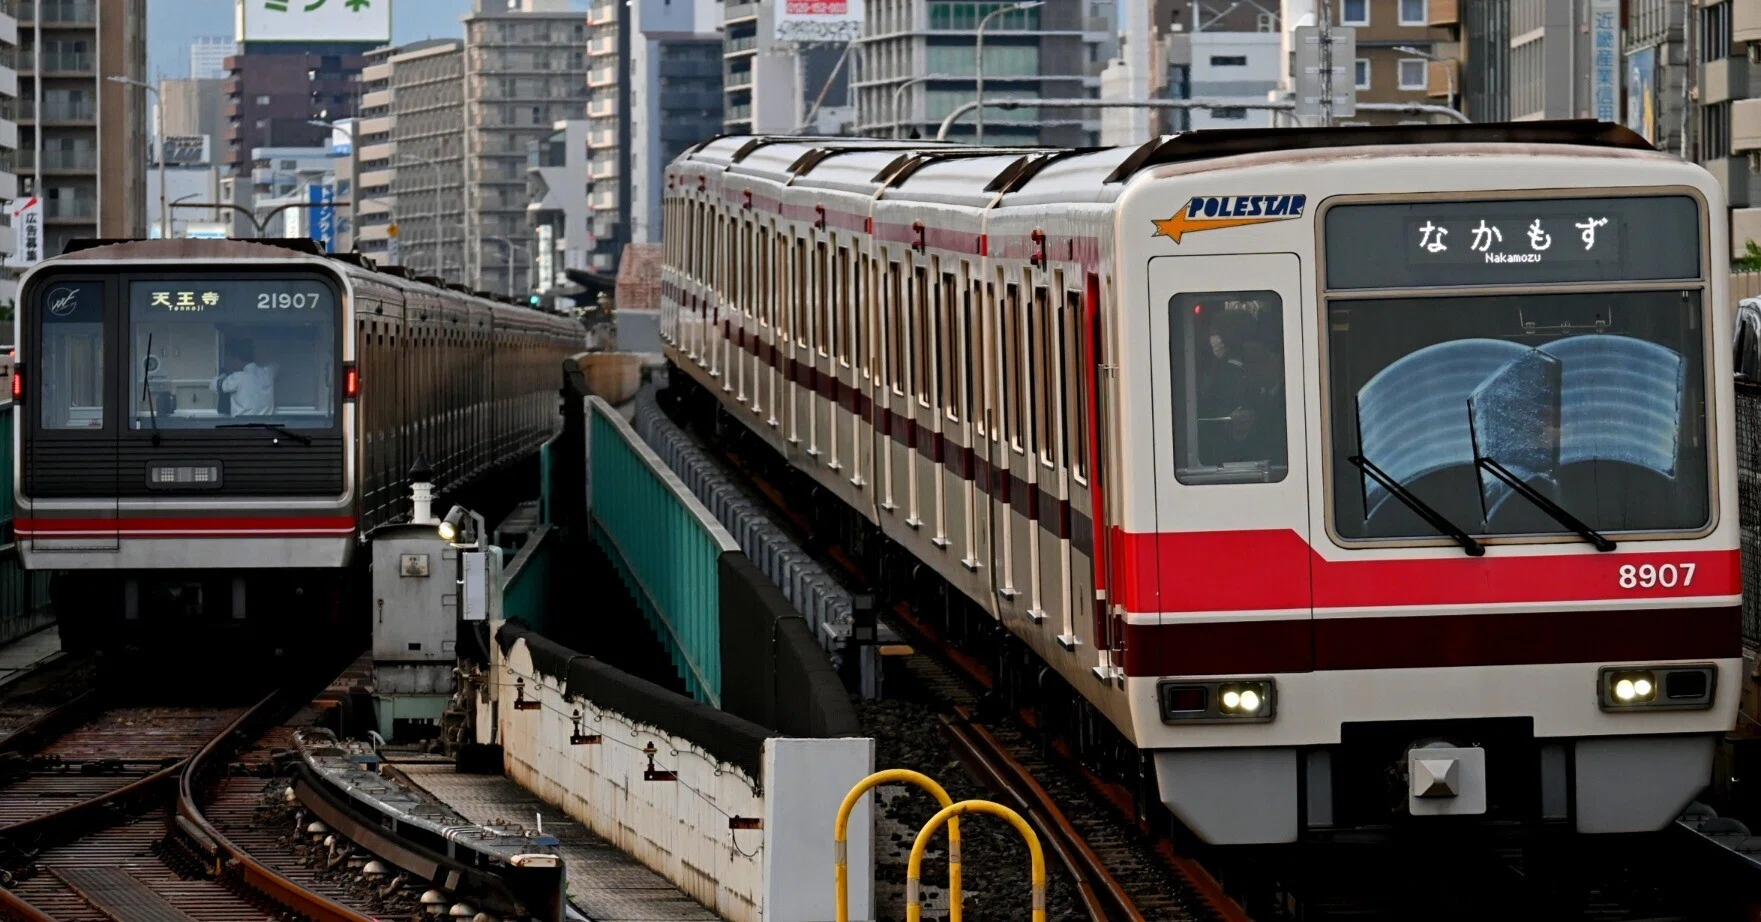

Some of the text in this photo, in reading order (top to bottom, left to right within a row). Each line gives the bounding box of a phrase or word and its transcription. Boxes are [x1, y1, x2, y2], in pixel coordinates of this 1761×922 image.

[1187, 195, 1306, 218] POLESTAR
[26, 212, 38, 262] 広告募集
[1419, 217, 1608, 252] なかもず
[1485, 252, 1541, 263] Nakamozu
[151, 291, 219, 306] 天王寺
[168, 304, 204, 312] Tennoji
[257, 293, 319, 309] 21907
[1619, 563, 1696, 588] 8907
